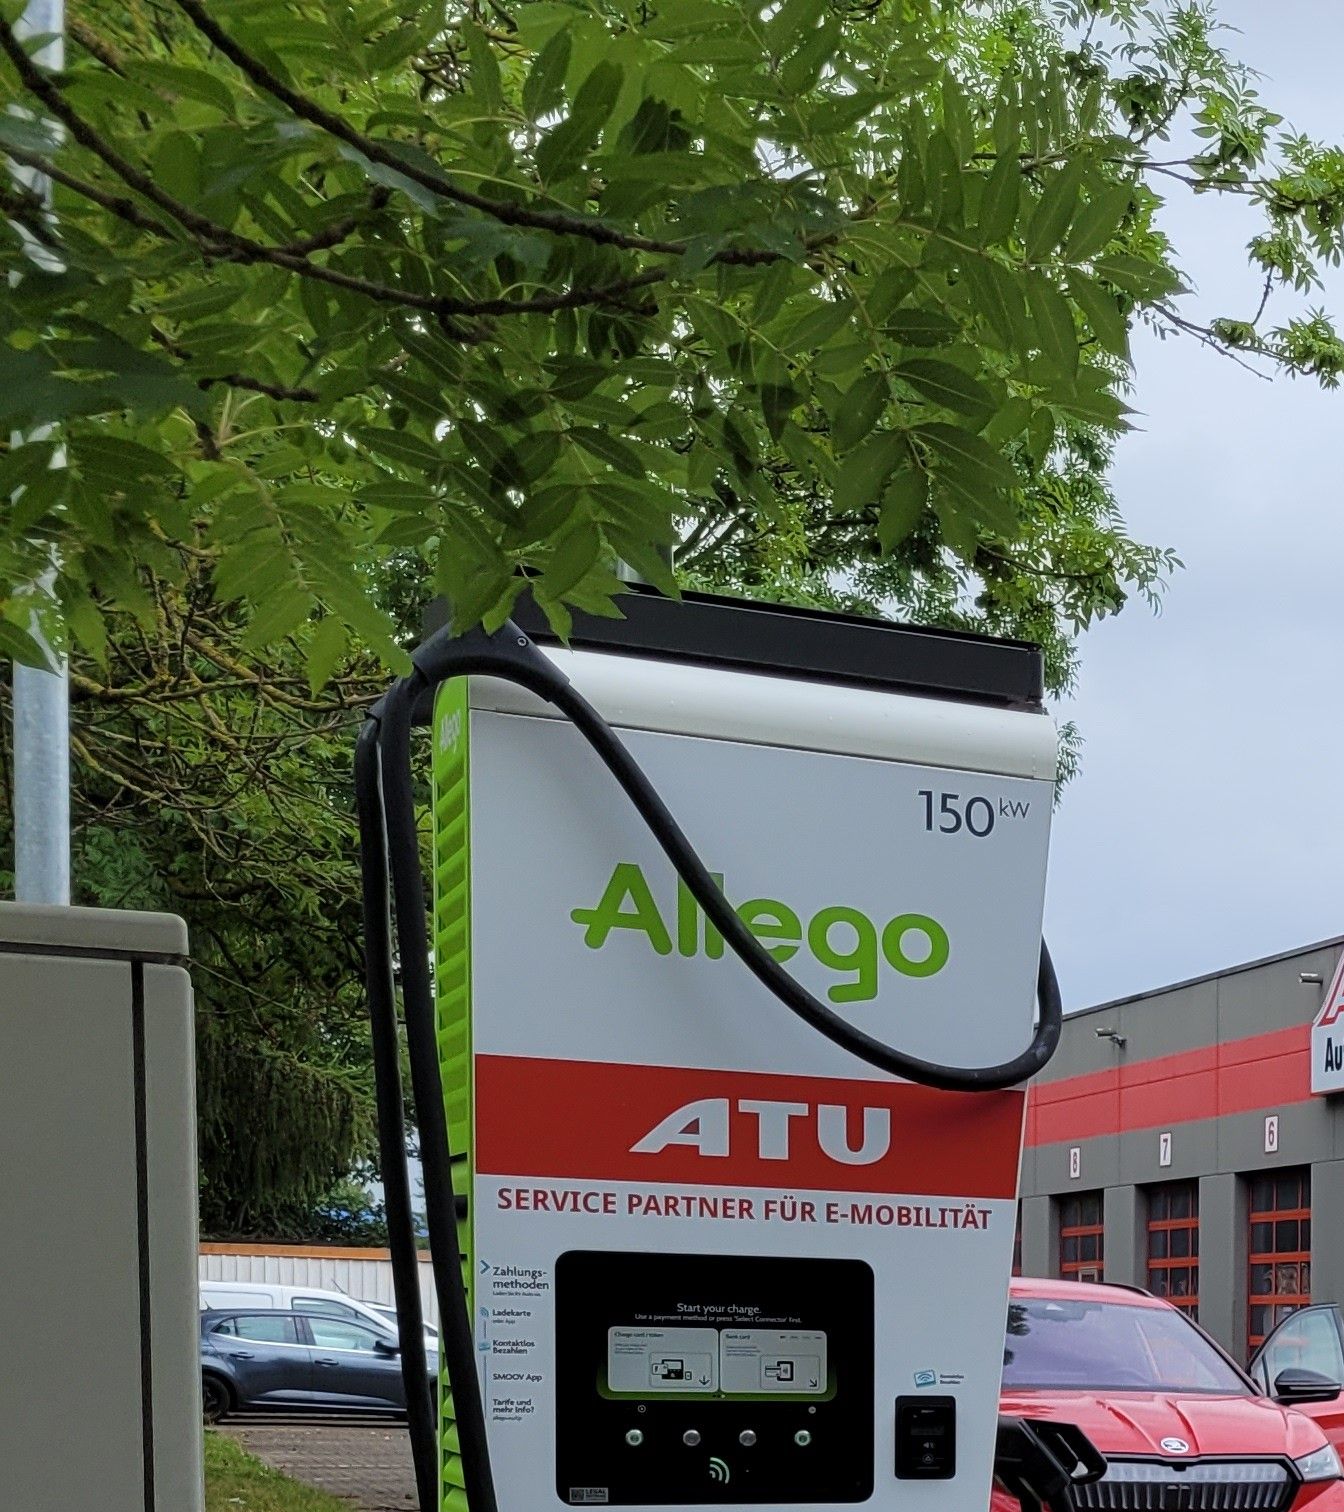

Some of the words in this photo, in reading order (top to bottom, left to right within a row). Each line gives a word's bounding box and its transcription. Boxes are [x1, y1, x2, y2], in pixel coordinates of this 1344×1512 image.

[918, 790, 994, 837] 150
[570, 863, 950, 1002] Allego
[629, 1098, 891, 1166] ATU
[1268, 1121, 1275, 1147] 6
[1162, 1138, 1169, 1161] 7
[497, 1187, 618, 1215] SERVICE
[627, 1194, 755, 1220] PARTNER
[764, 1194, 817, 1223] FÜR
[826, 1200, 993, 1230] E-MOBILITÄT
[493, 1265, 547, 1280] Zahlungs-
[493, 1278, 549, 1290] methoden
[492, 1309, 531, 1318] Ladekarte
[677, 1303, 700, 1312] Start
[703, 1305, 725, 1314] your
[526, 1374, 543, 1382] App
[516, 1398, 532, 1406] und
